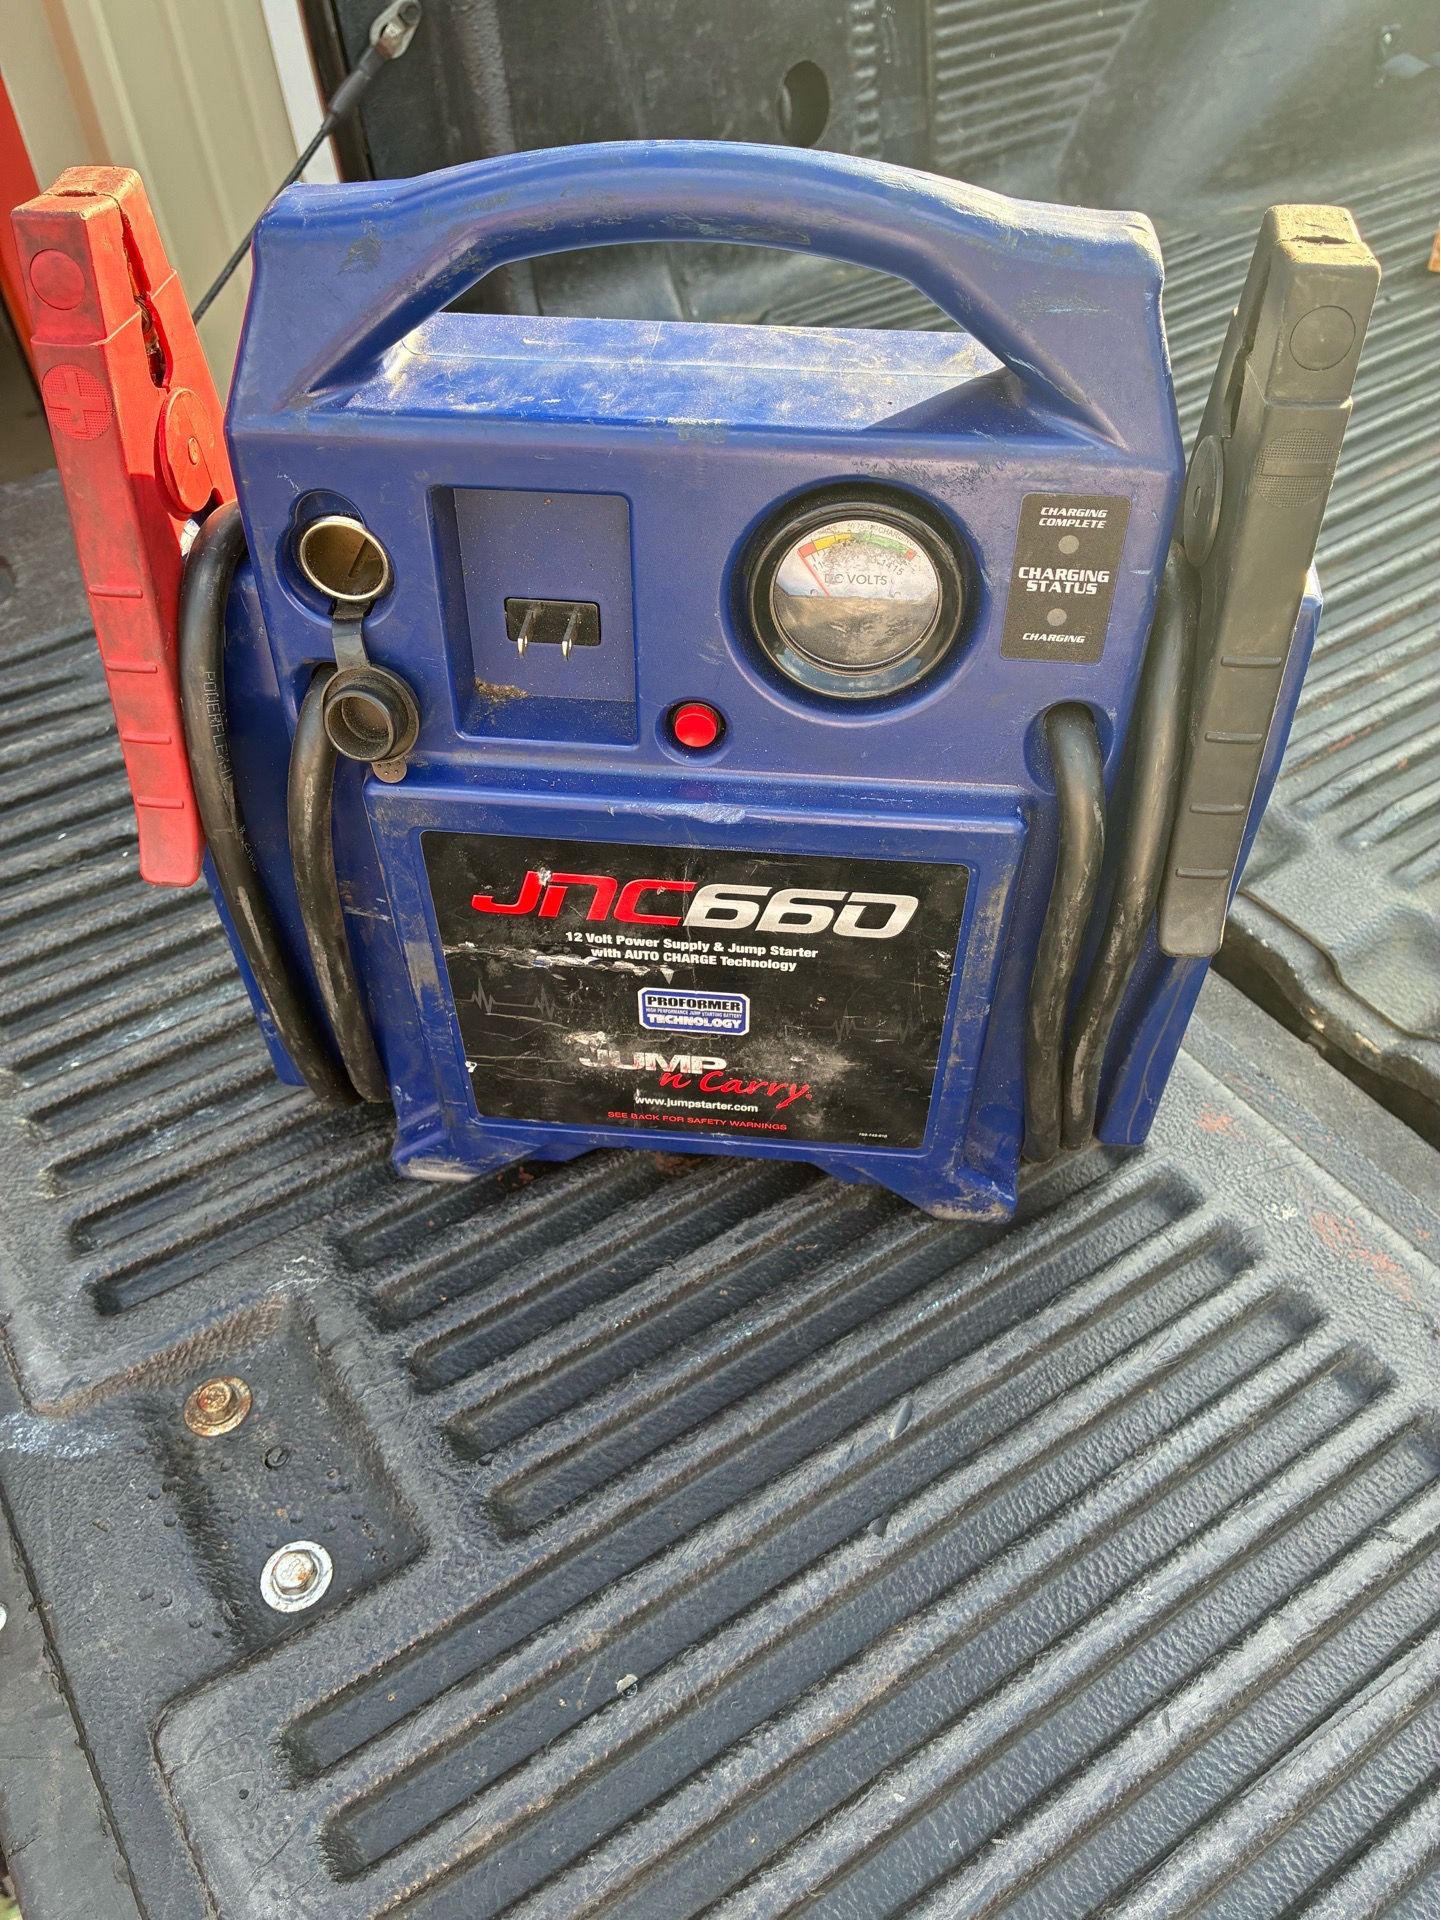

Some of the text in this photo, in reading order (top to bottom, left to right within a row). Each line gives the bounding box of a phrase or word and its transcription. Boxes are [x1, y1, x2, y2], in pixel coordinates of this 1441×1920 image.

[1040, 506, 1108, 518] CHARGING
[1038, 517, 1106, 529] COMPLETE
[847, 574, 888, 586] VOLTS
[1018, 566, 1110, 583] CHARGING
[1026, 579, 1098, 595] STATUS
[1022, 632, 1086, 644] CHARGING
[565, 932, 818, 958] 12 Volt Power Supply & Jump Starter
[591, 948, 797, 972] with AUTO CHARGE Technology
[647, 996, 741, 1011] PROFORMER
[657, 1008, 688, 1016] PERFORMANCE
[646, 1013, 742, 1029] TECHNOLOGY
[578, 1048, 728, 1074] JUMP
[659, 1070, 692, 1089] n
[635, 1096, 759, 1113] www.jumpstarter.com
[607, 1111, 788, 1131] SEE BACK FOR SAFETY WARNINGS
